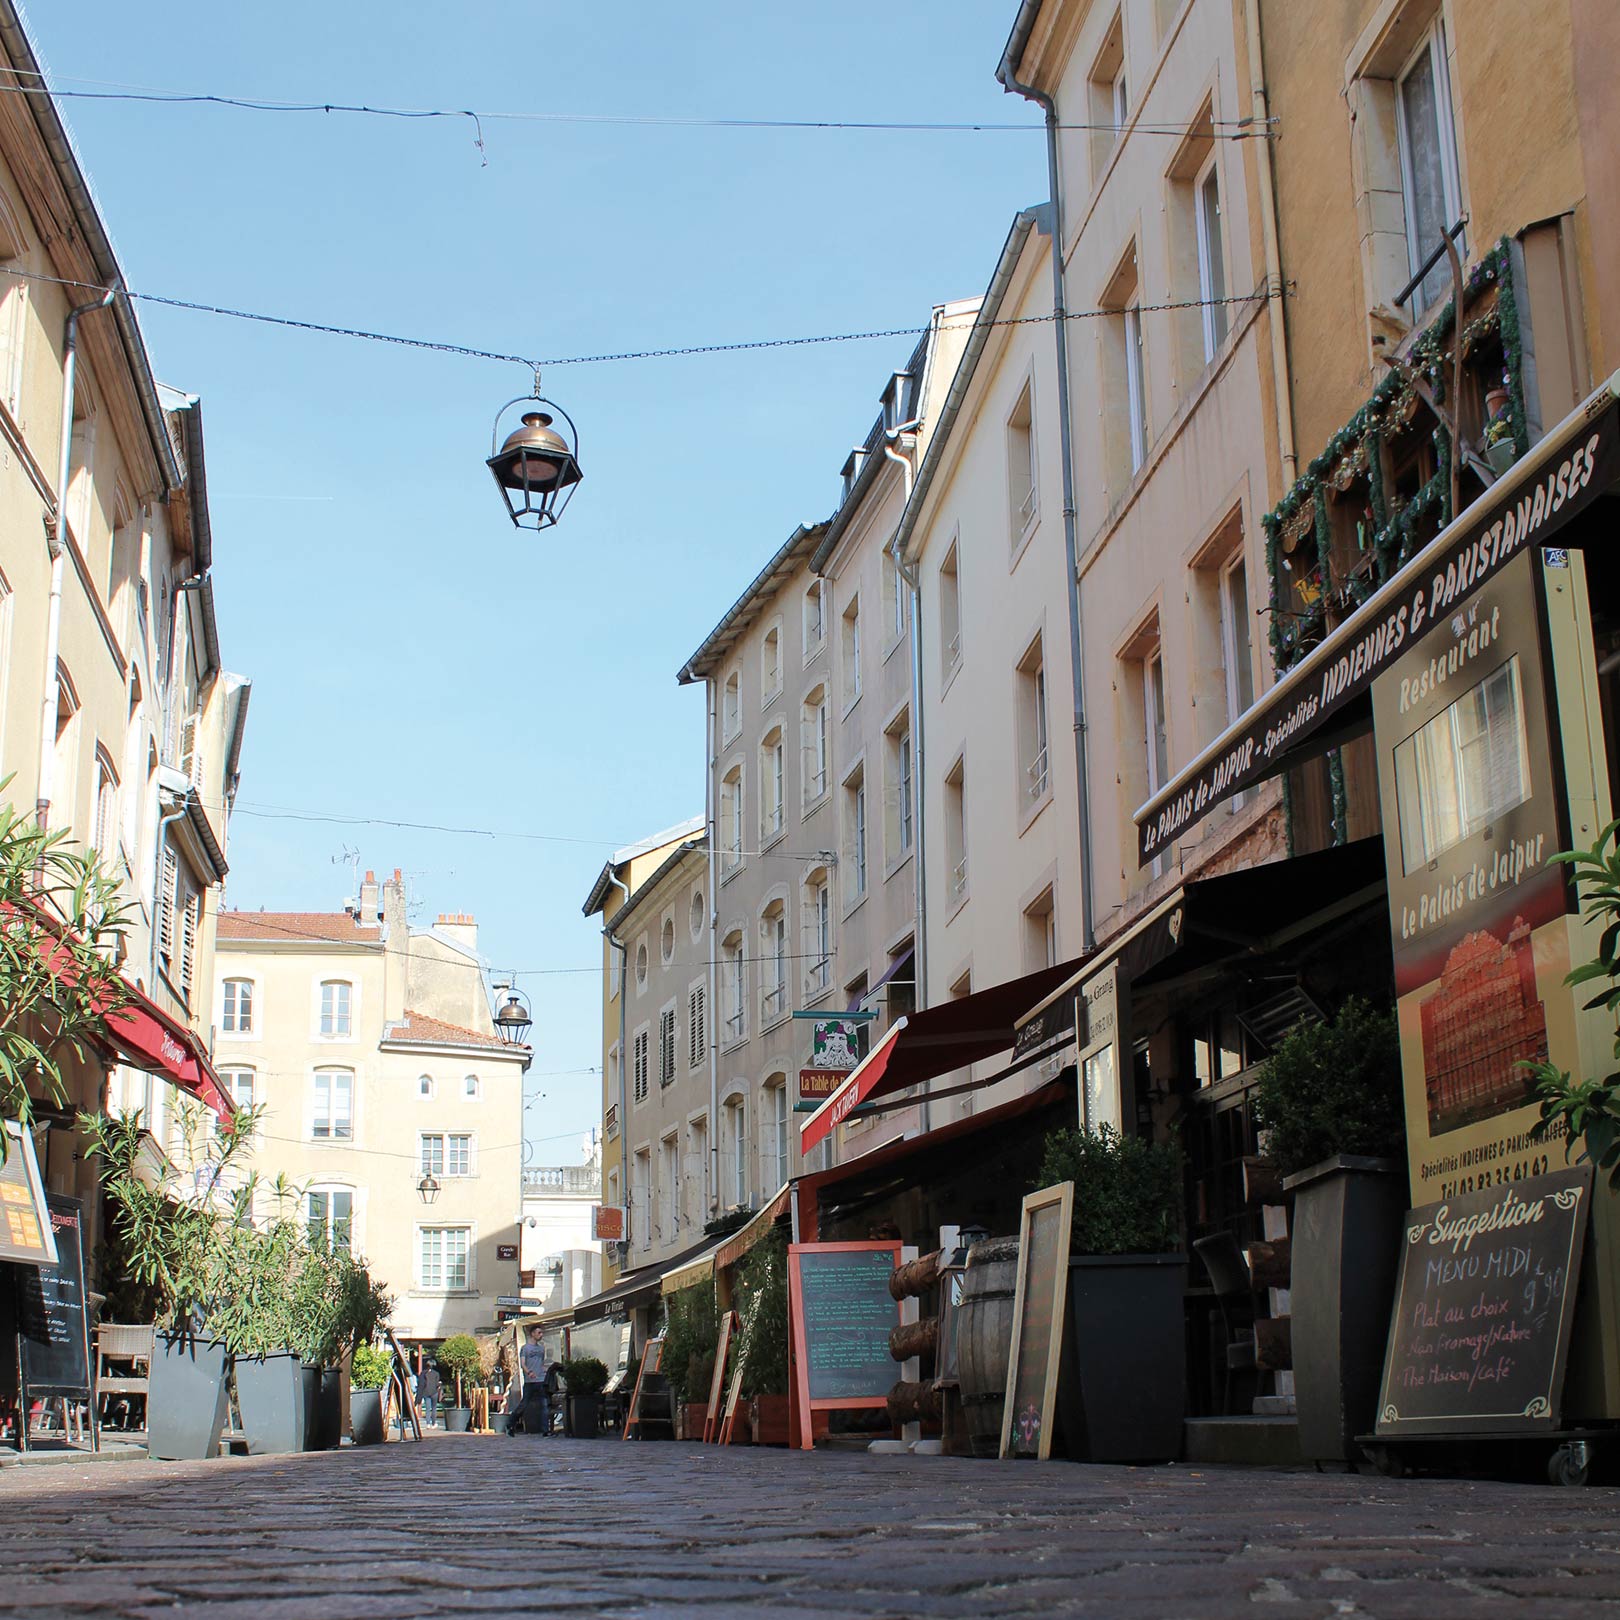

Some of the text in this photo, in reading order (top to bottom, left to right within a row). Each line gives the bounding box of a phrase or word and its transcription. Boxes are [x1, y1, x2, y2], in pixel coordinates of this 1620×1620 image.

[1144, 823, 1156, 853] Le
[1157, 787, 1194, 843] PALAIS
[1194, 778, 1209, 812] de
[1208, 737, 1254, 800] JAIPUR
[1263, 694, 1318, 758] Spécialités
[1320, 605, 1408, 709] INDIENNES
[1429, 433, 1600, 618] PAKISTANAISES
[1400, 606, 1500, 714] Restaurant
[1402, 833, 1544, 939] Le Palais de Jaipur
[801, 1076, 810, 1091] La
[811, 1075, 828, 1091] Table
[830, 1075, 839, 1091] de
[1421, 1155, 1458, 1182] Spécialités
[1459, 1142, 1497, 1169] INDIENNES
[1429, 1189, 1544, 1254] Suggestion
[1426, 1254, 1480, 1288] MENU
[1482, 1246, 1532, 1279] MIDI
[1413, 1292, 1509, 1329] Plat au choix
